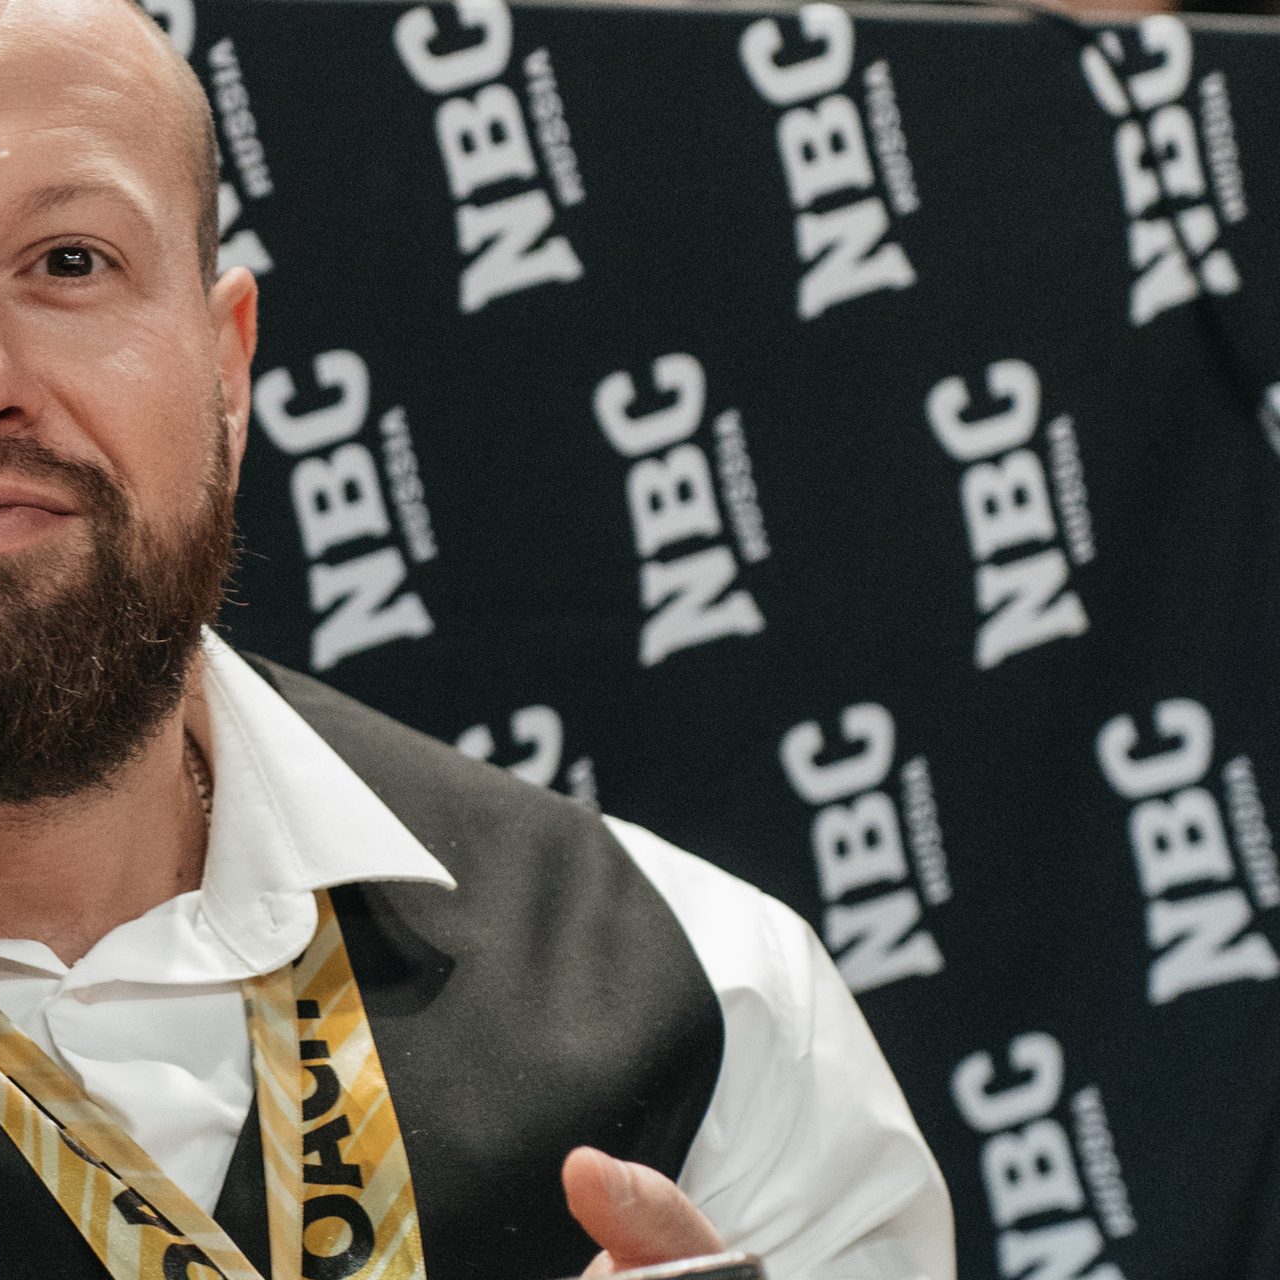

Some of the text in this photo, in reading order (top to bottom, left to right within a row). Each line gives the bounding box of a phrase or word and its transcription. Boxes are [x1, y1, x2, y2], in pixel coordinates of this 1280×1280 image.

[739, 2, 917, 320] NBC
[1080, 14, 1240, 325] NBC
[252, 349, 434, 671] NBC
[593, 352, 765, 666] NBC
[925, 358, 1088, 669] NBC
[780, 702, 945, 996] NBC
[1096, 698, 1280, 1005] NBC
